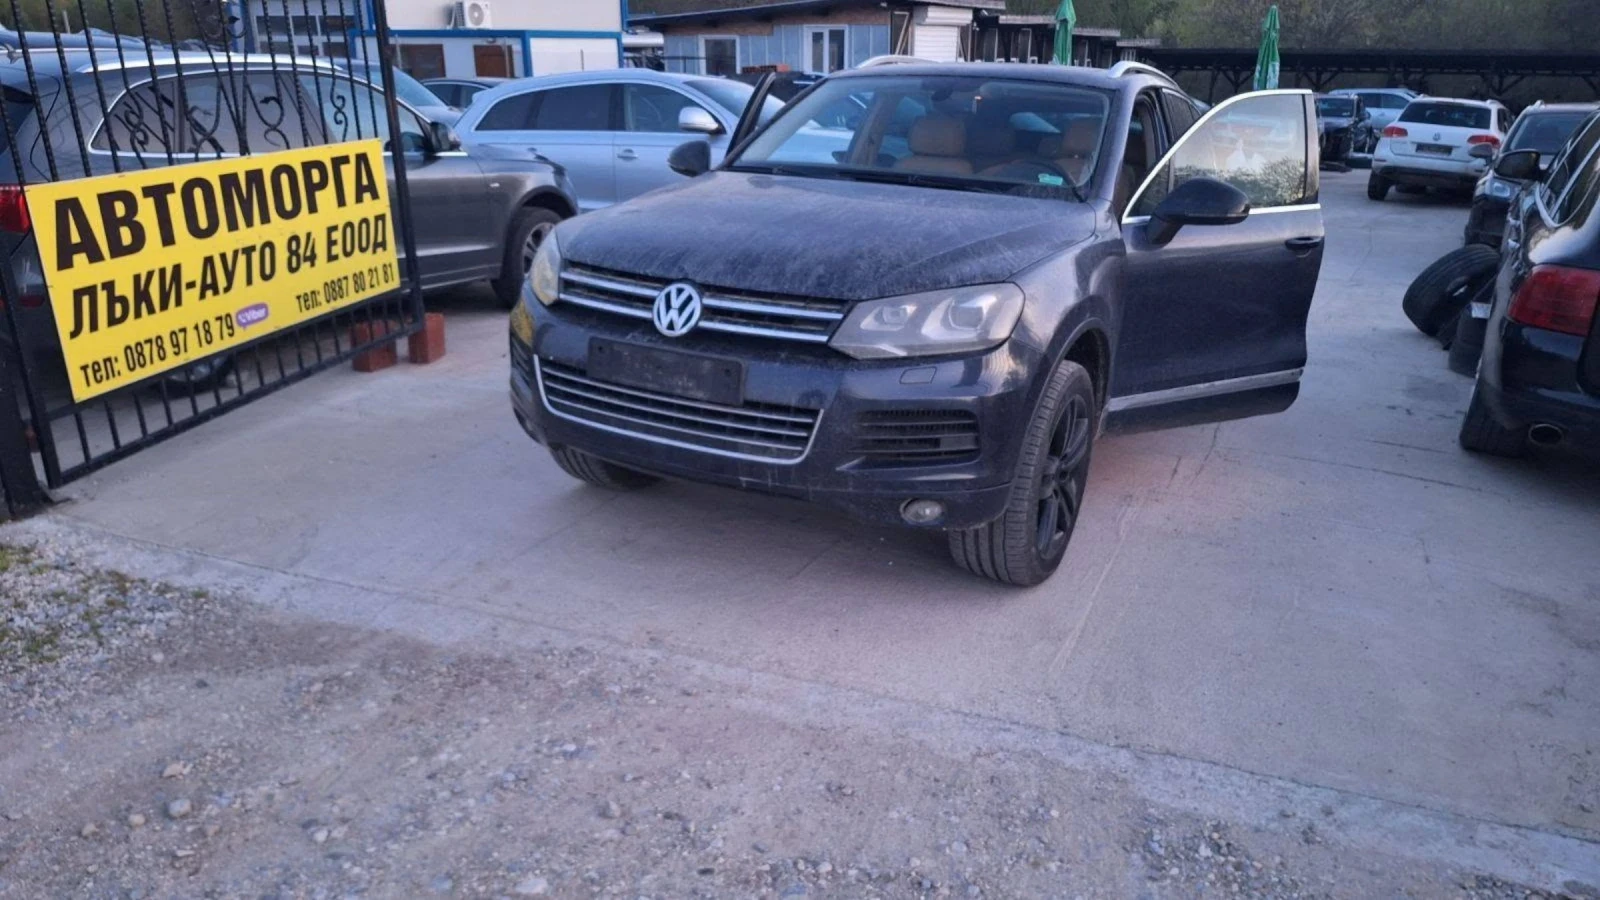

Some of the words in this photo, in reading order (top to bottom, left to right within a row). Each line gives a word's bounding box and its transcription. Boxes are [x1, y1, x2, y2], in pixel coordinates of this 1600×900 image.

[55, 152, 380, 271] АВТОМОРГА
[69, 240, 276, 339] ЛЪКИ-АУТО
[287, 231, 317, 274] 84
[326, 213, 387, 263] ЕООД
[296, 289, 322, 313] тел:
[323, 276, 349, 304] 0887
[352, 270, 365, 294] 80
[369, 267, 380, 289] 21
[383, 262, 394, 284] 81
[654, 283, 701, 337] VW
[80, 355, 121, 387] тел:
[124, 335, 166, 372] 0878
[169, 327, 188, 356] 97
[193, 320, 213, 348] 18
[215, 313, 235, 337] 79
